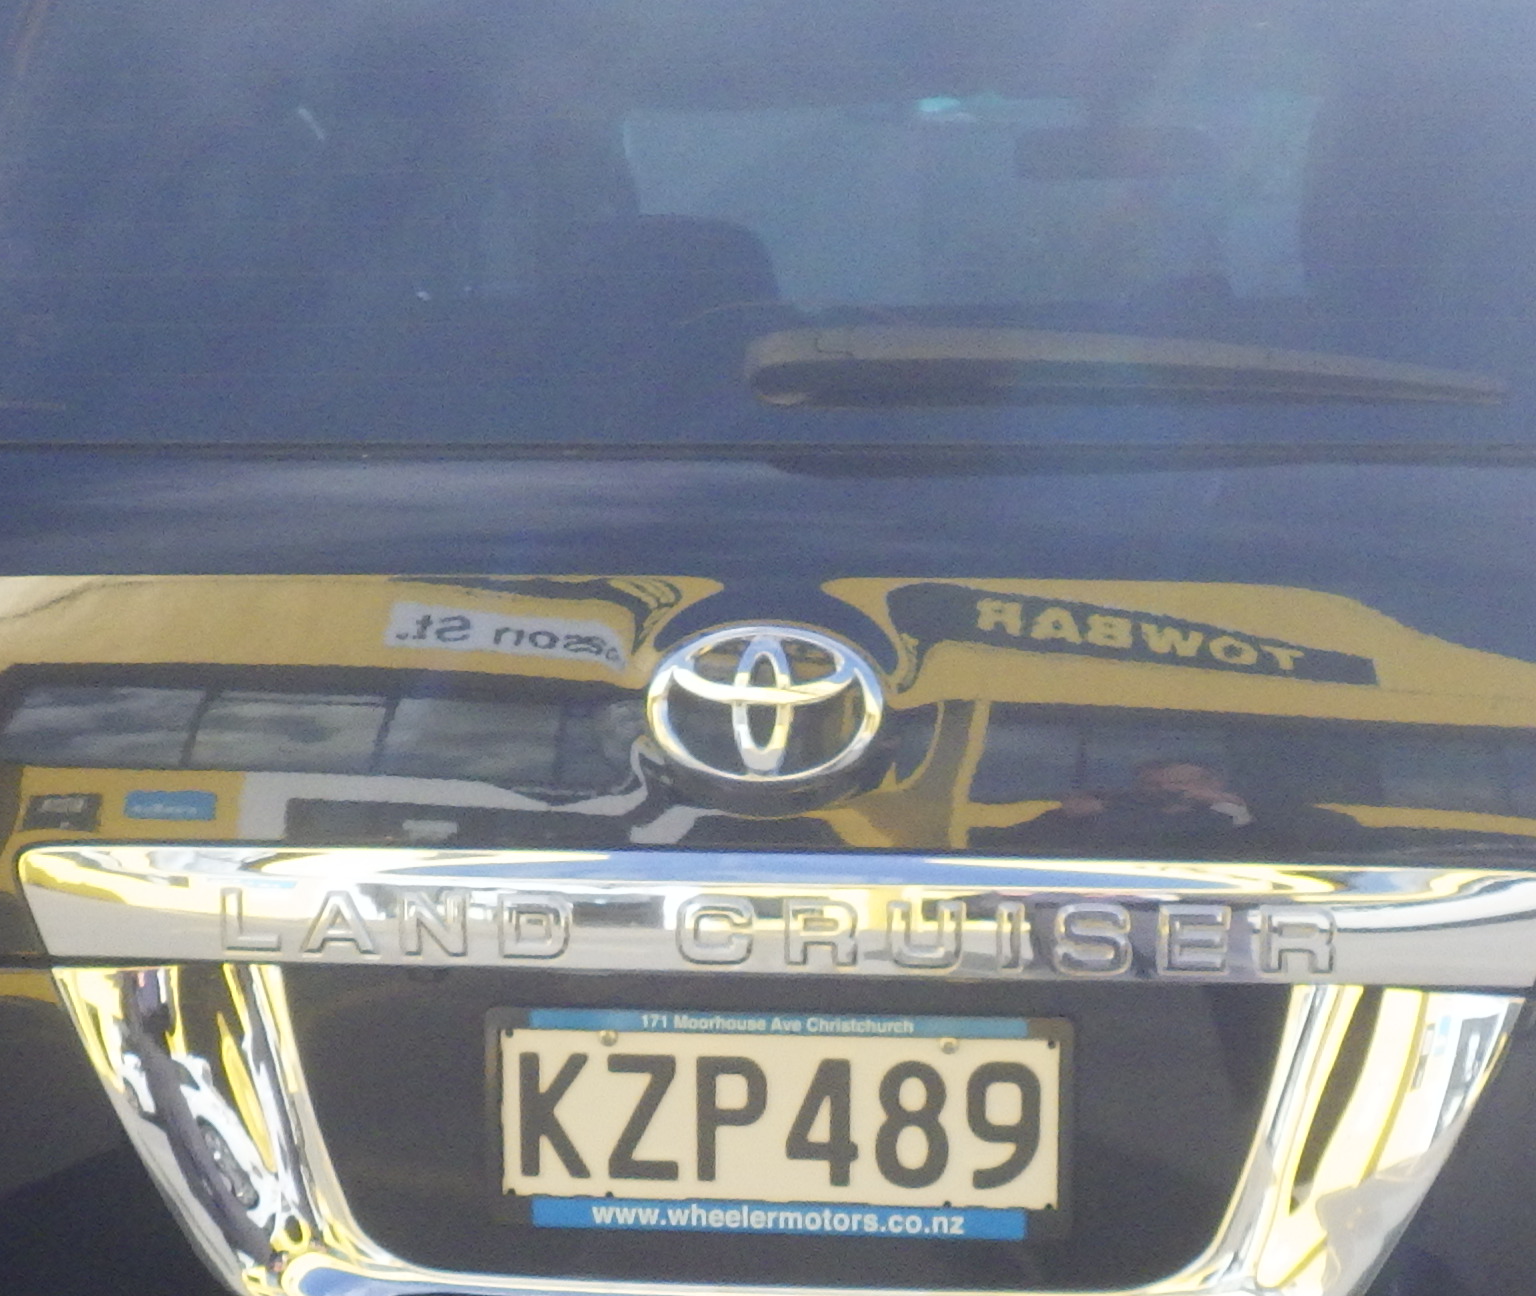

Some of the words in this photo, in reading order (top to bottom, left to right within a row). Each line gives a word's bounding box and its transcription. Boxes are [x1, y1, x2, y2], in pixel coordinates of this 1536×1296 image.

[220, 886, 573, 960] LAND
[675, 895, 1338, 977] CRUISER
[642, 1014, 668, 1029] 171
[673, 1015, 767, 1032] Moorhouse
[770, 1017, 802, 1033] Ave
[806, 1017, 914, 1034] Christchurch
[518, 1051, 1041, 1190] KZP489
[592, 1203, 965, 1235] www.wheelermotors.co.nz
